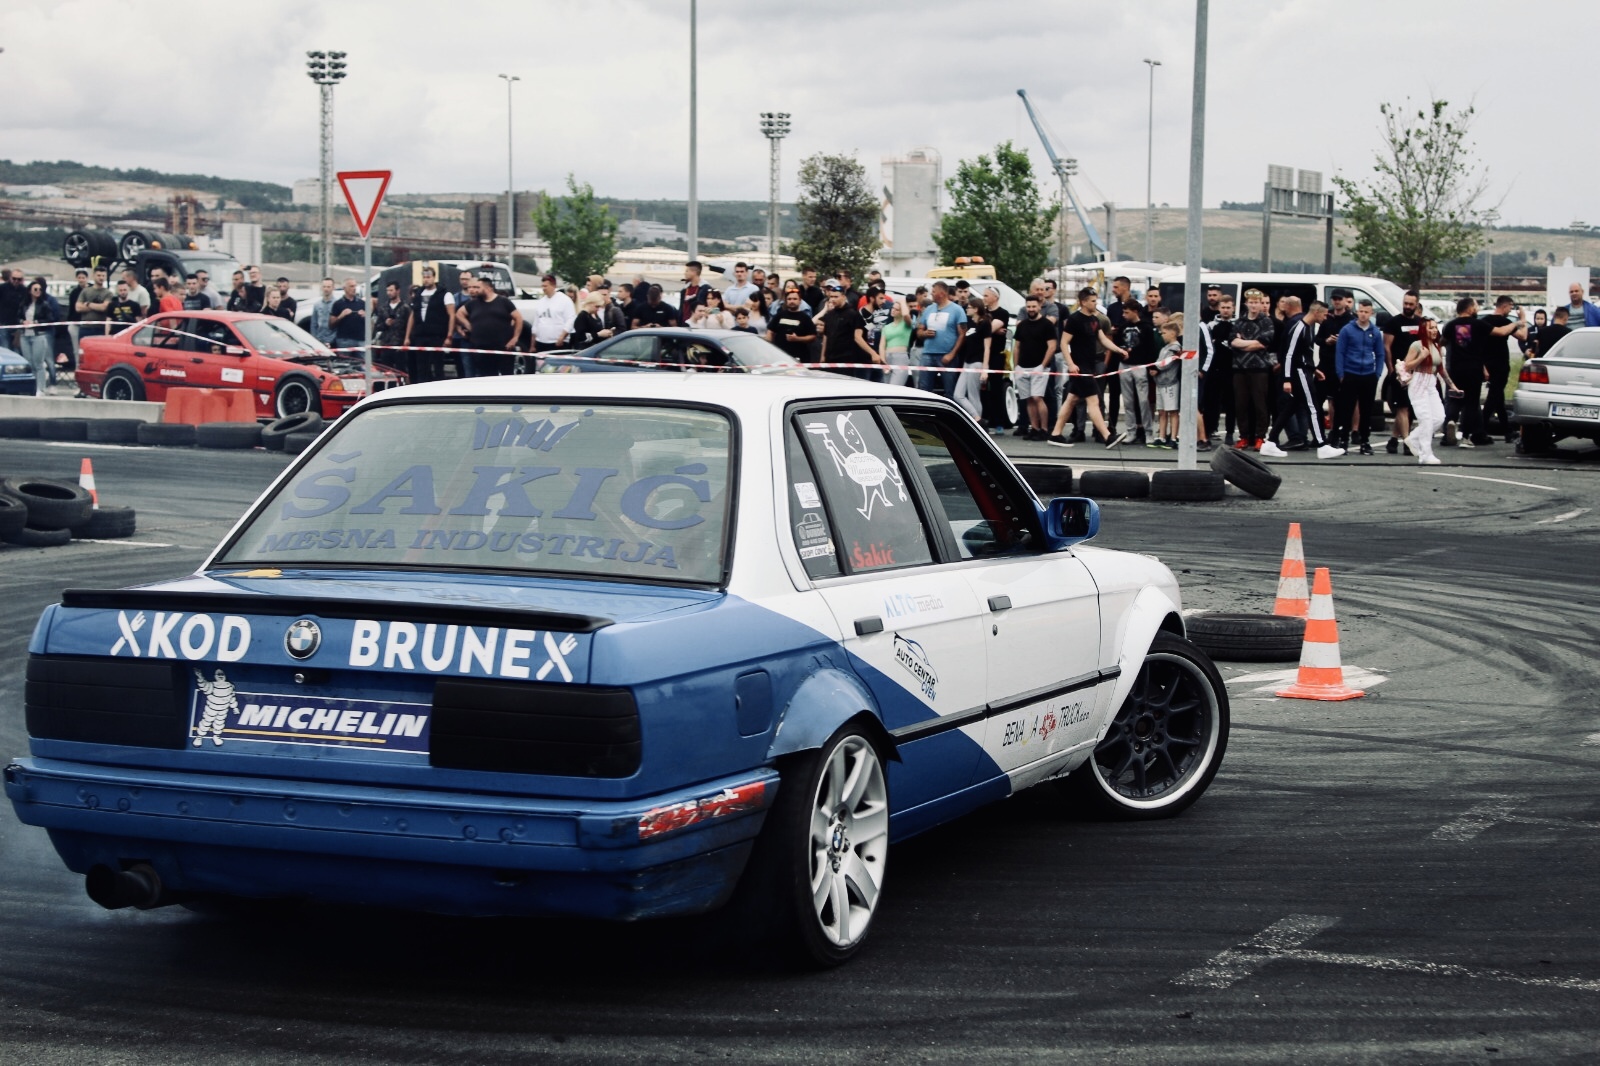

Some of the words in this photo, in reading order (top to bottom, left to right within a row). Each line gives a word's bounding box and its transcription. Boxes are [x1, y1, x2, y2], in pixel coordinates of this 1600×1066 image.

[281, 450, 712, 530] ŠAKIĆ
[257, 528, 396, 554] MESNA
[413, 529, 679, 570] INDUSTRIJA
[883, 593, 917, 618] ALTO
[917, 595, 945, 612] media
[896, 647, 913, 668] AUTO
[913, 662, 936, 690] CENTAR
[921, 681, 937, 702] CVEN
[237, 703, 429, 738] MICHELIN
